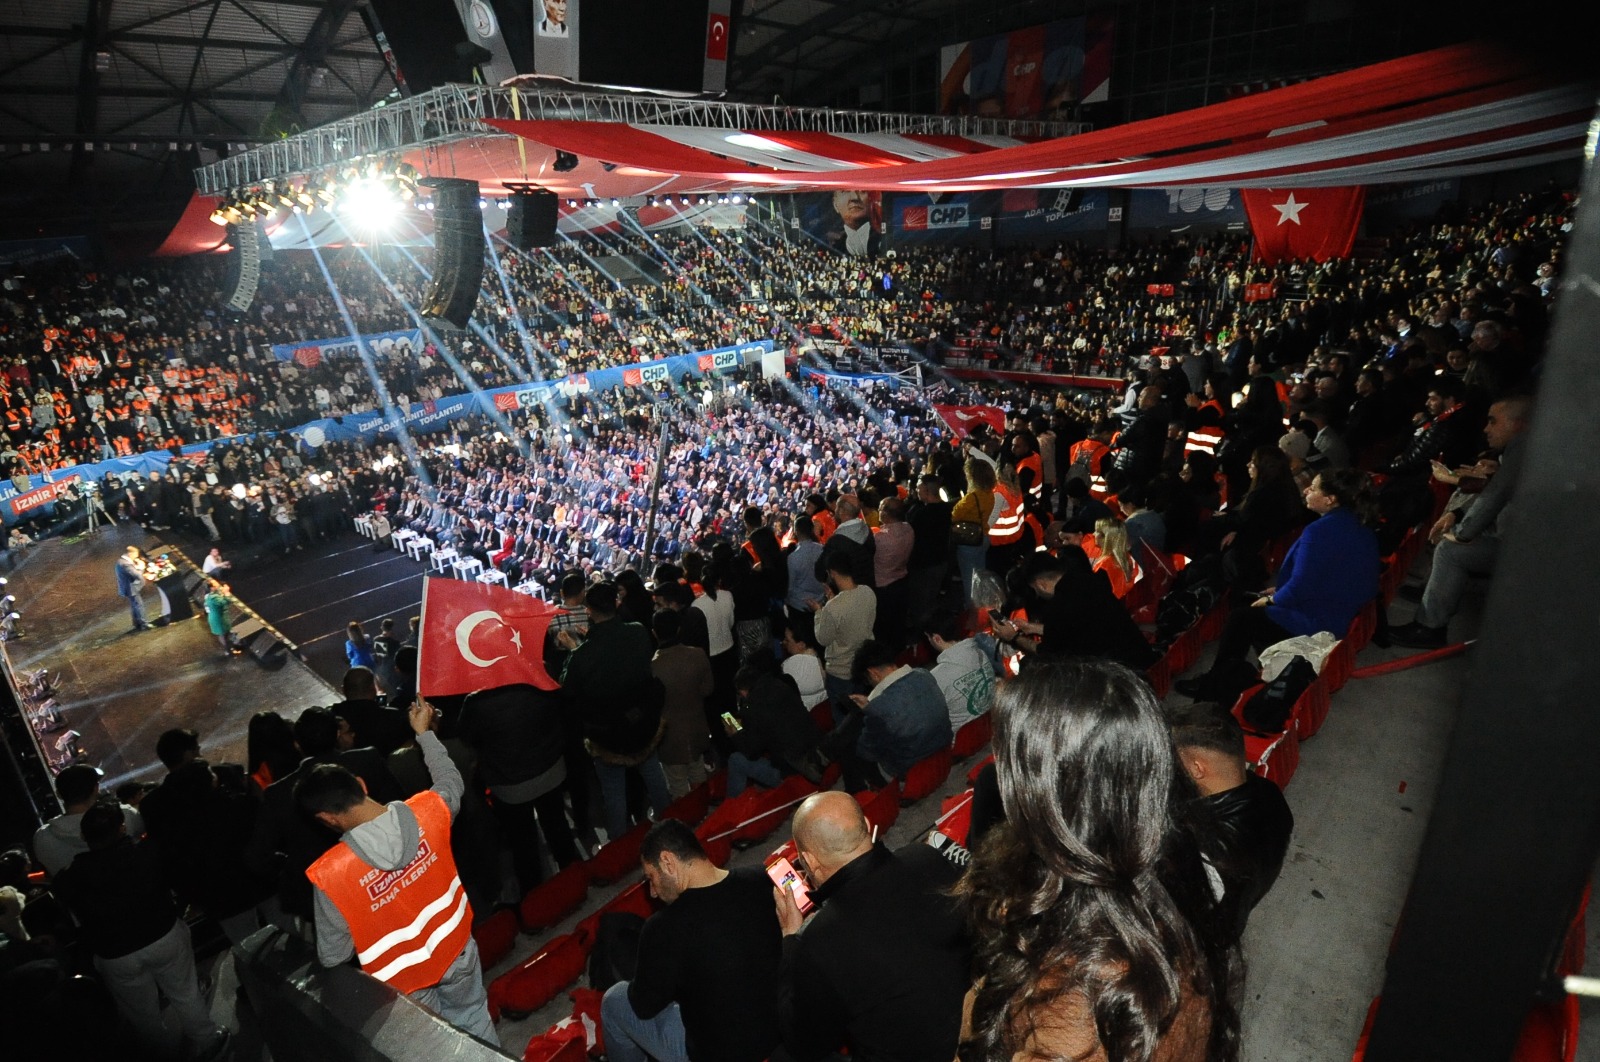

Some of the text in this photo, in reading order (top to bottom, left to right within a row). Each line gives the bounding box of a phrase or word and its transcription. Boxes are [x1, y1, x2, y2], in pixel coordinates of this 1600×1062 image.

[929, 205, 967, 225] CHP
[714, 353, 735, 366] CHP
[642, 366, 666, 381] CHP
[518, 388, 548, 406] CHP
[419, 402, 464, 426] TOPLANTISI
[359, 417, 384, 433] İZMİR
[378, 419, 400, 433] ADAY
[14, 489, 52, 511] İZMİR
[370, 886, 400, 912] DAHA
[400, 851, 438, 888] İLERİYE
